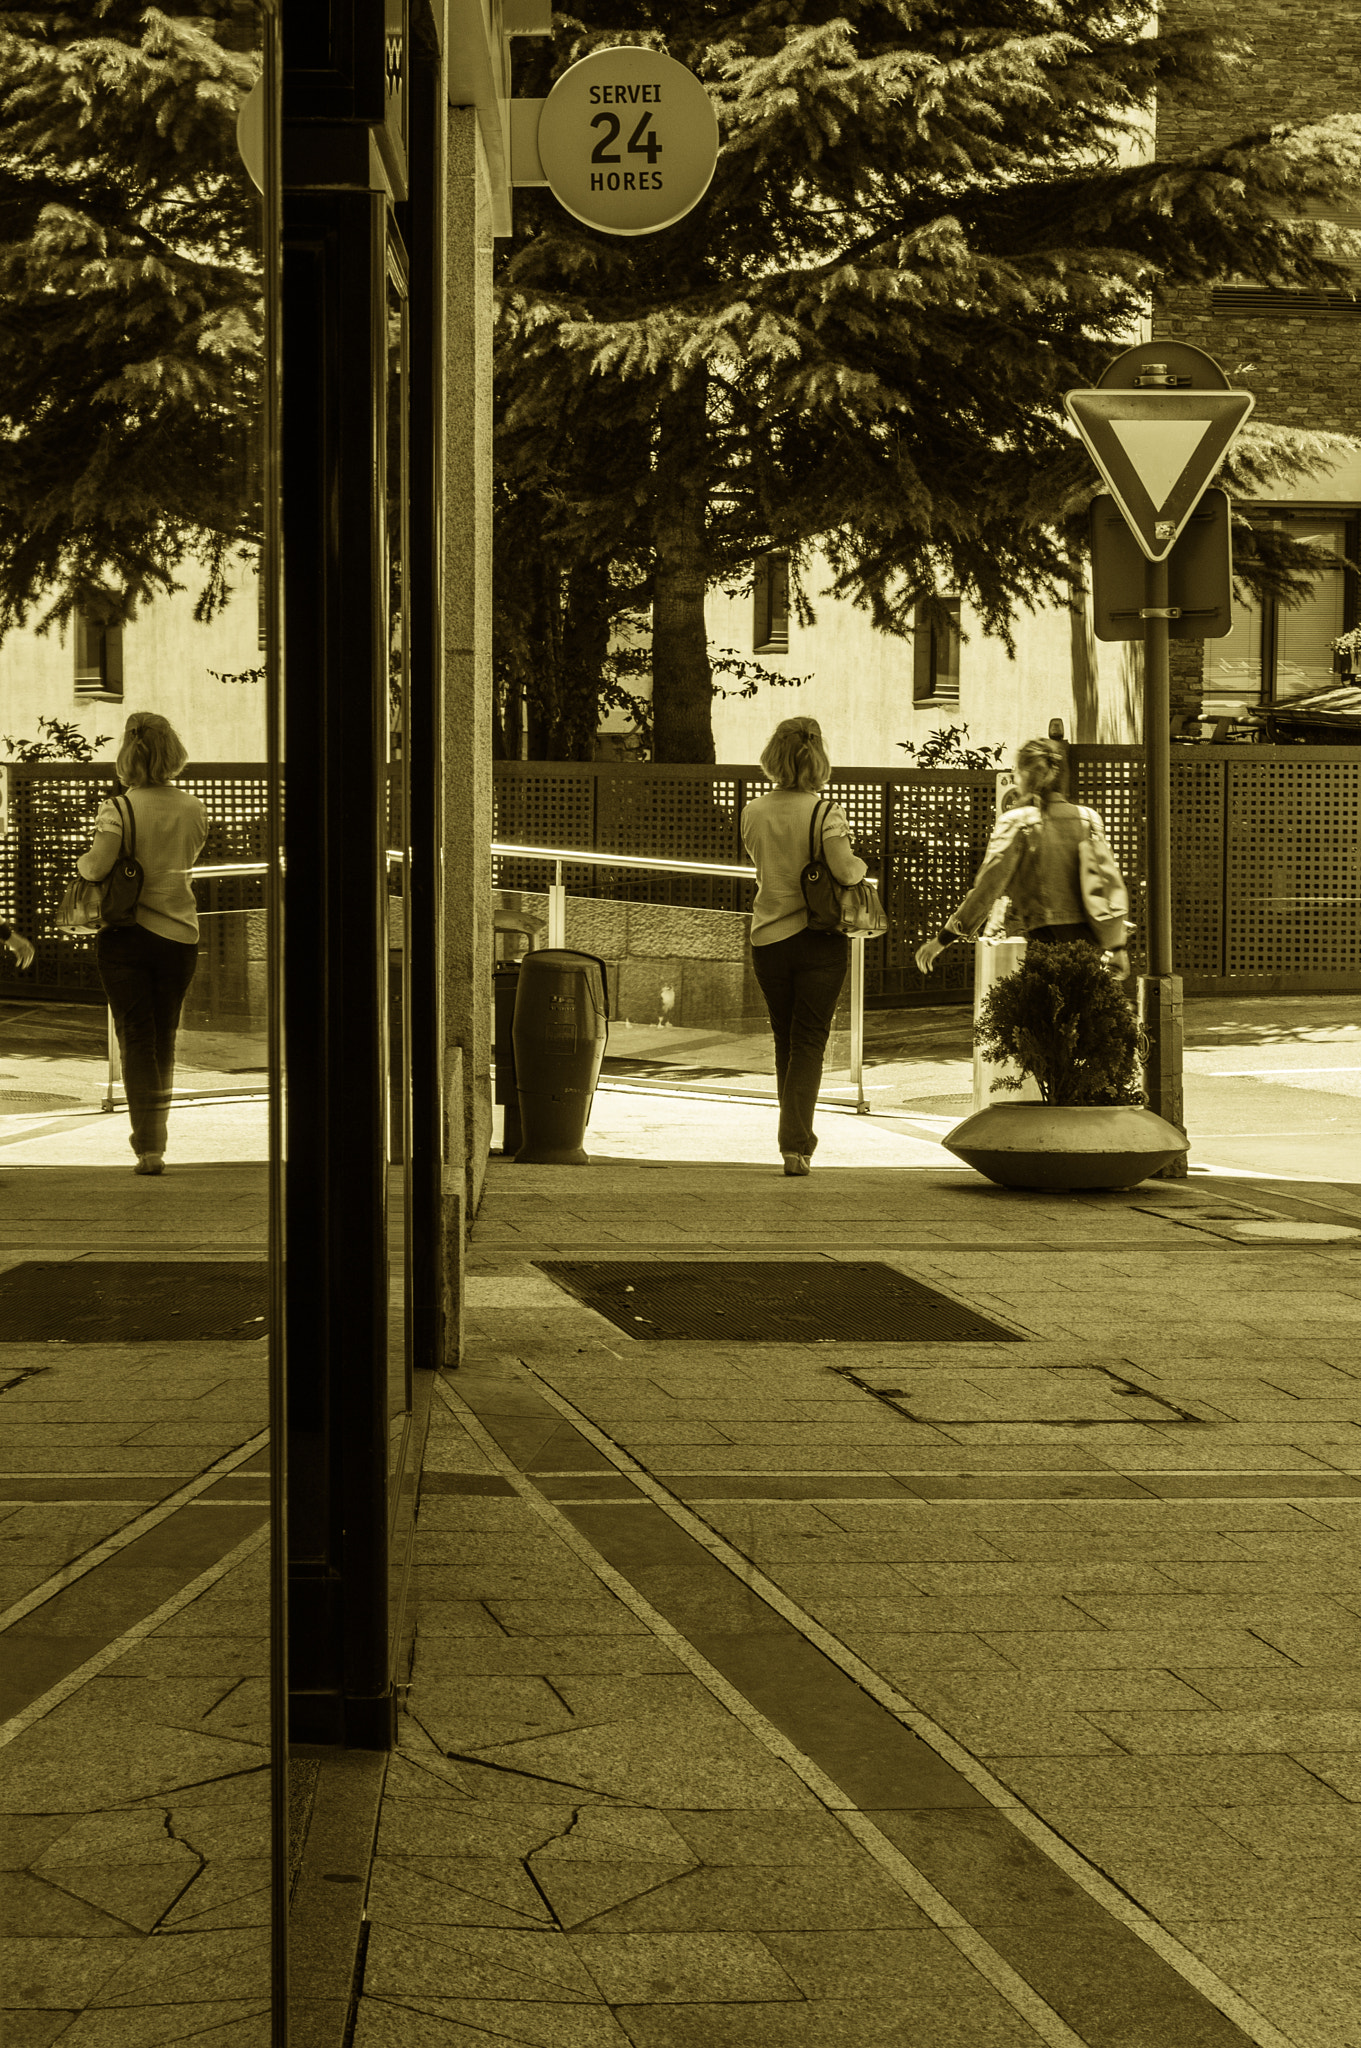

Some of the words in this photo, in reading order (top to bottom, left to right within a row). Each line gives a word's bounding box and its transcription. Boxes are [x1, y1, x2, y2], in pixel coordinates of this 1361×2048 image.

[589, 84, 662, 104] SERVEI
[590, 111, 663, 164] 24
[590, 171, 663, 191] HORES
